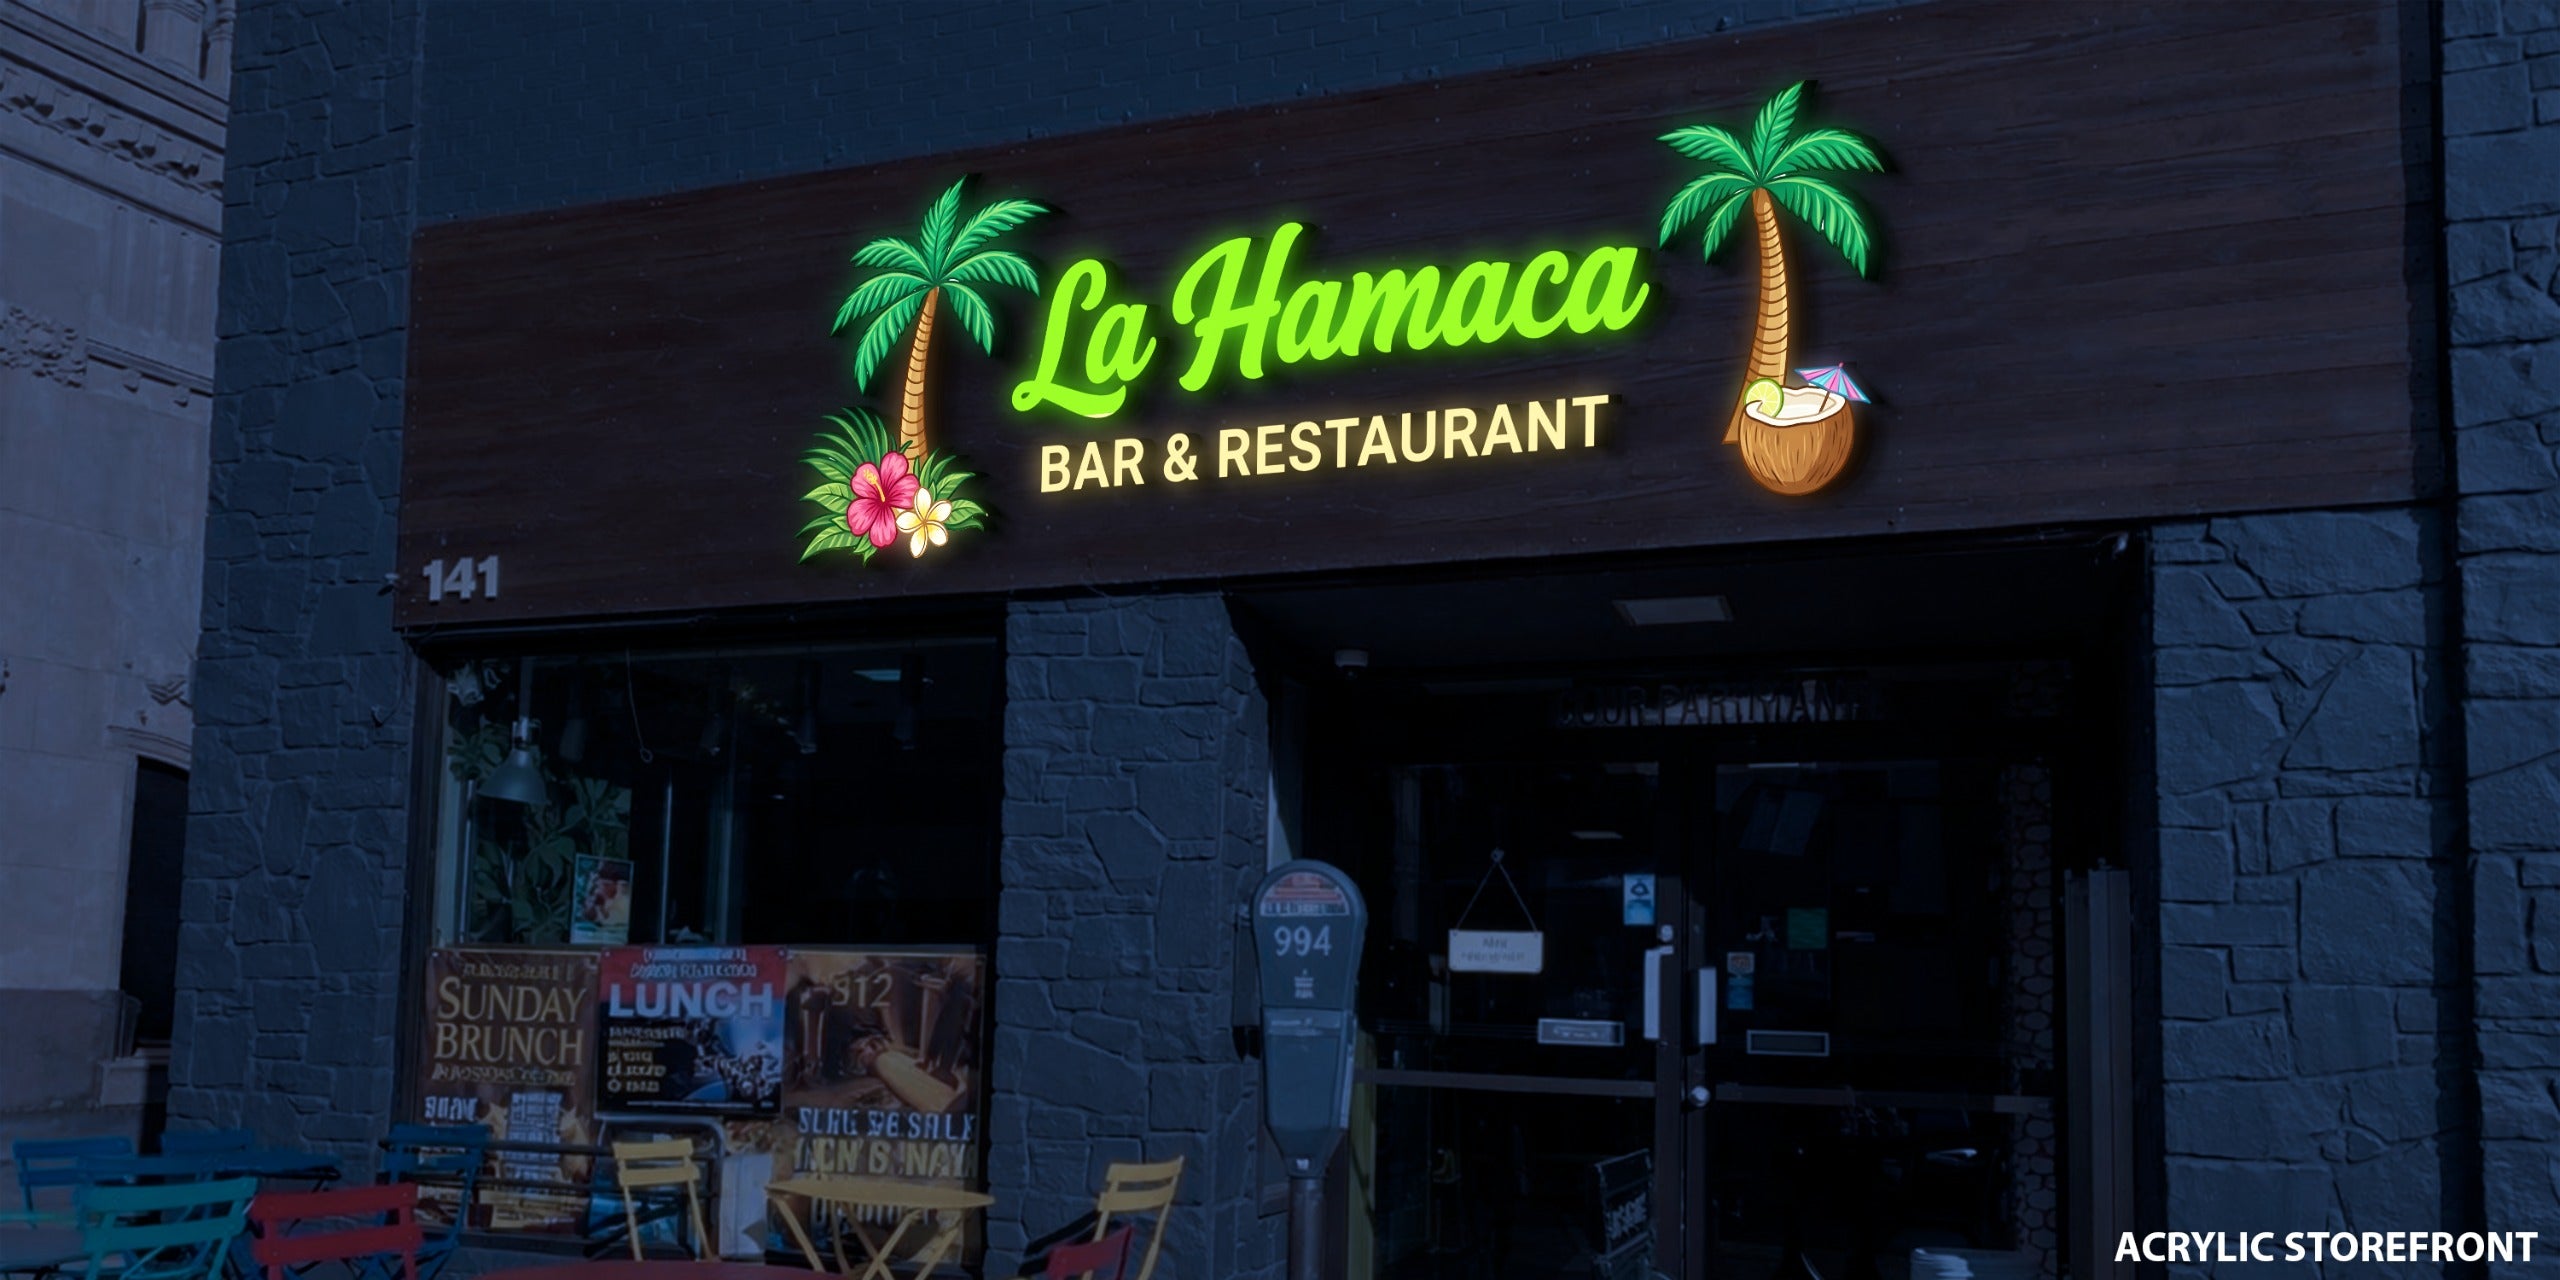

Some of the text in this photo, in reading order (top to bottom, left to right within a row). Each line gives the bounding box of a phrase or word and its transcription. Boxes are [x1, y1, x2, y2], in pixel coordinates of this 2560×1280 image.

[1012, 222, 1650, 418] La Hamaca
[1040, 395, 1609, 493] BAR & RESTAURANT
[422, 554, 499, 603] 141
[1274, 924, 1333, 957] 994
[437, 976, 588, 1023] SUNDAY
[608, 980, 774, 1019] LUNCH
[433, 1021, 584, 1066] BRUNCH
